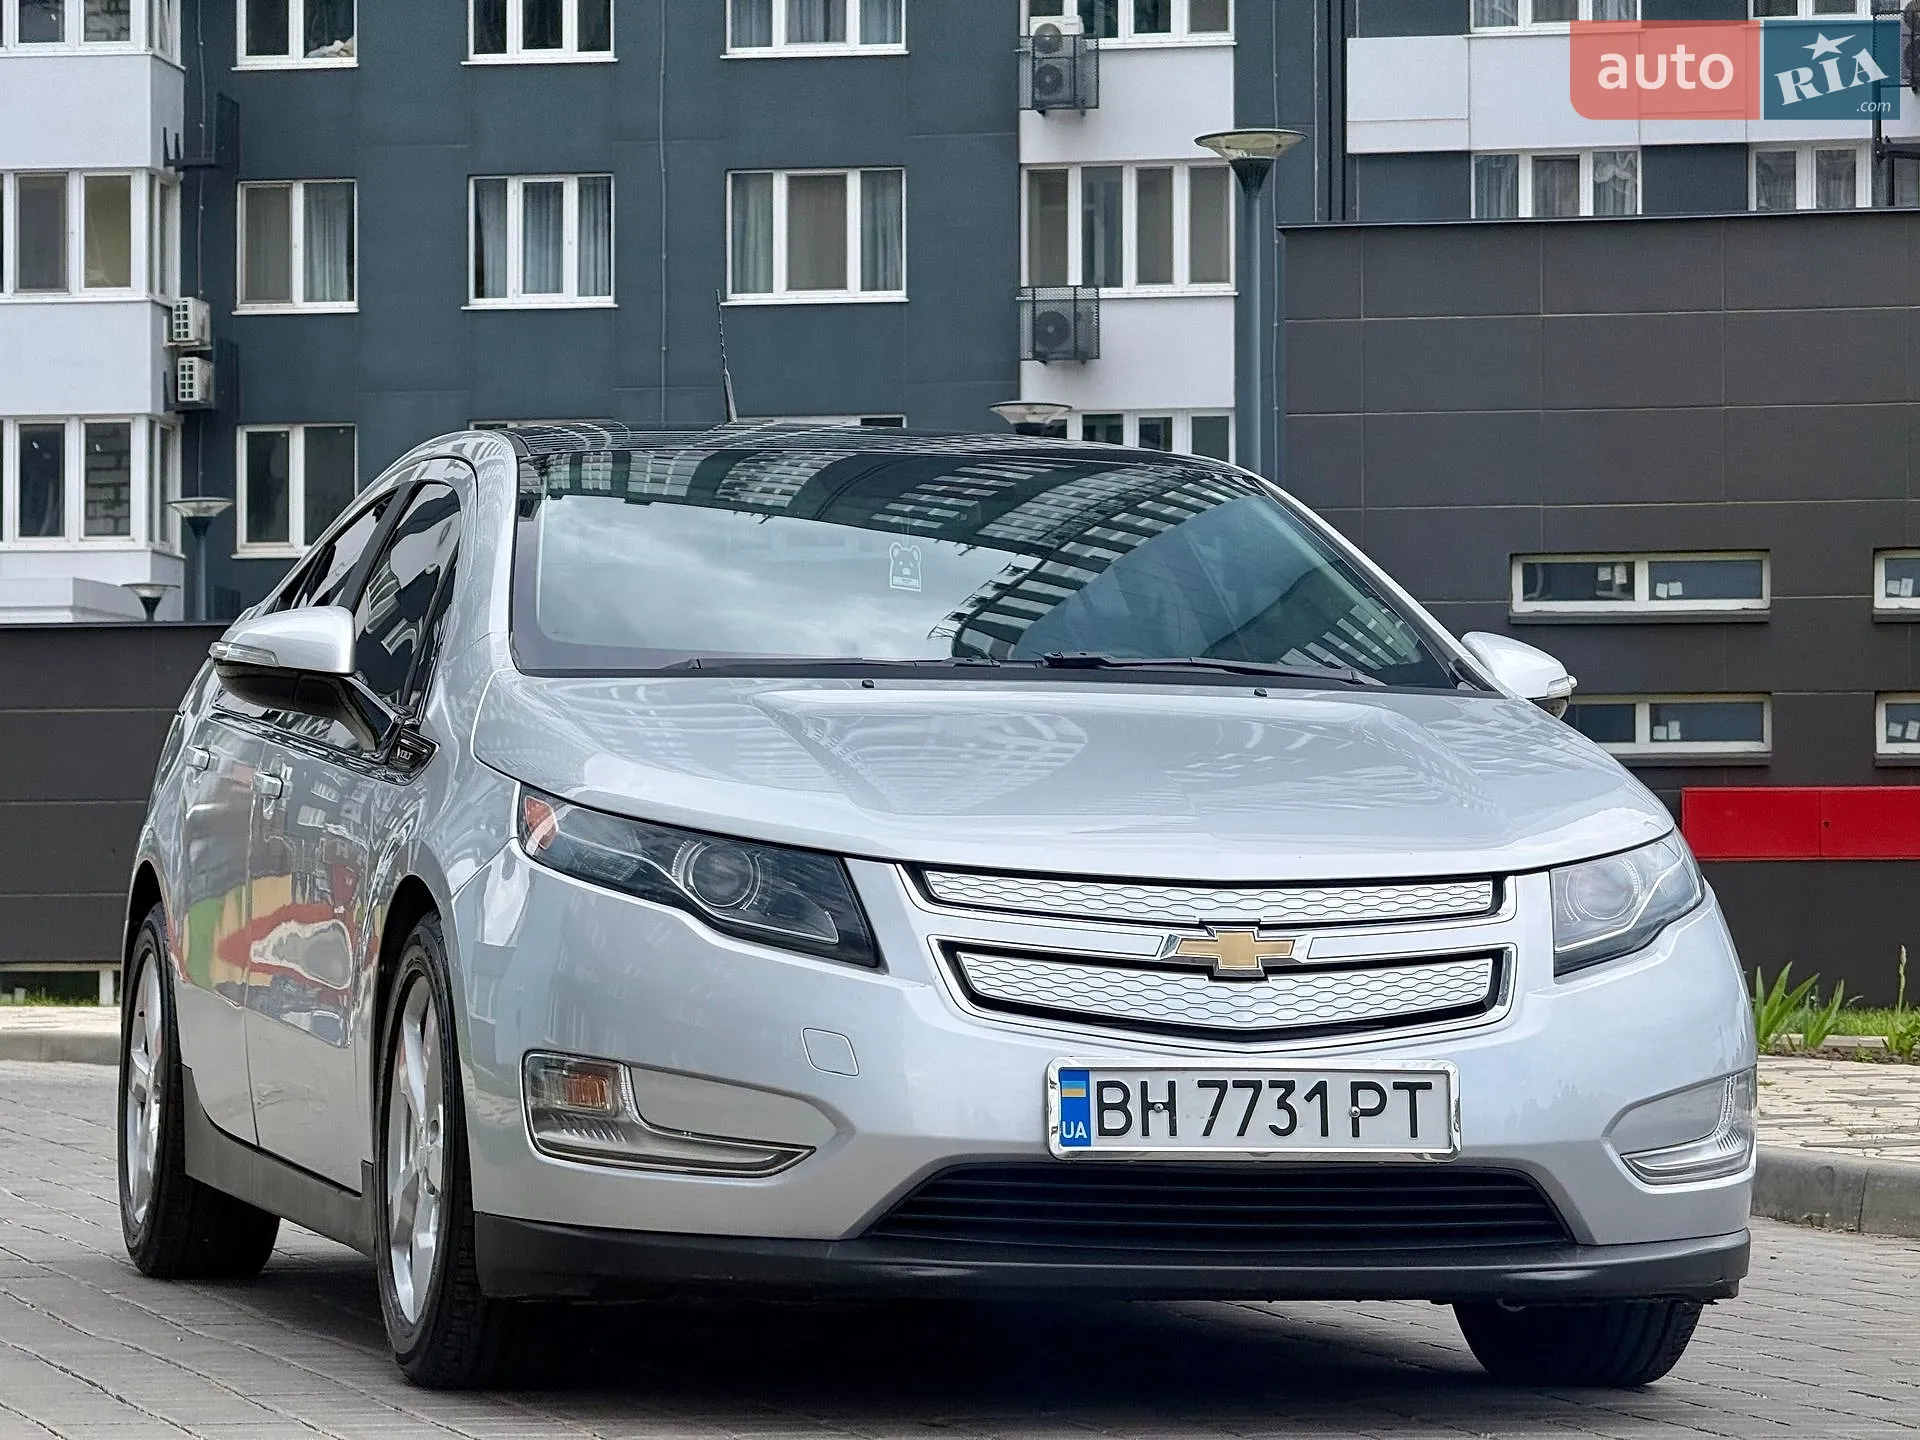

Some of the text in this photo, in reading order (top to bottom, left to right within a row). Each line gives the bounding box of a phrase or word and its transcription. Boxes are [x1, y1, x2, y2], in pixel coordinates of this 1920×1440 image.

[1096, 1080, 1433, 1138] BH 7731 PT
[1062, 1120, 1088, 1139] UA
